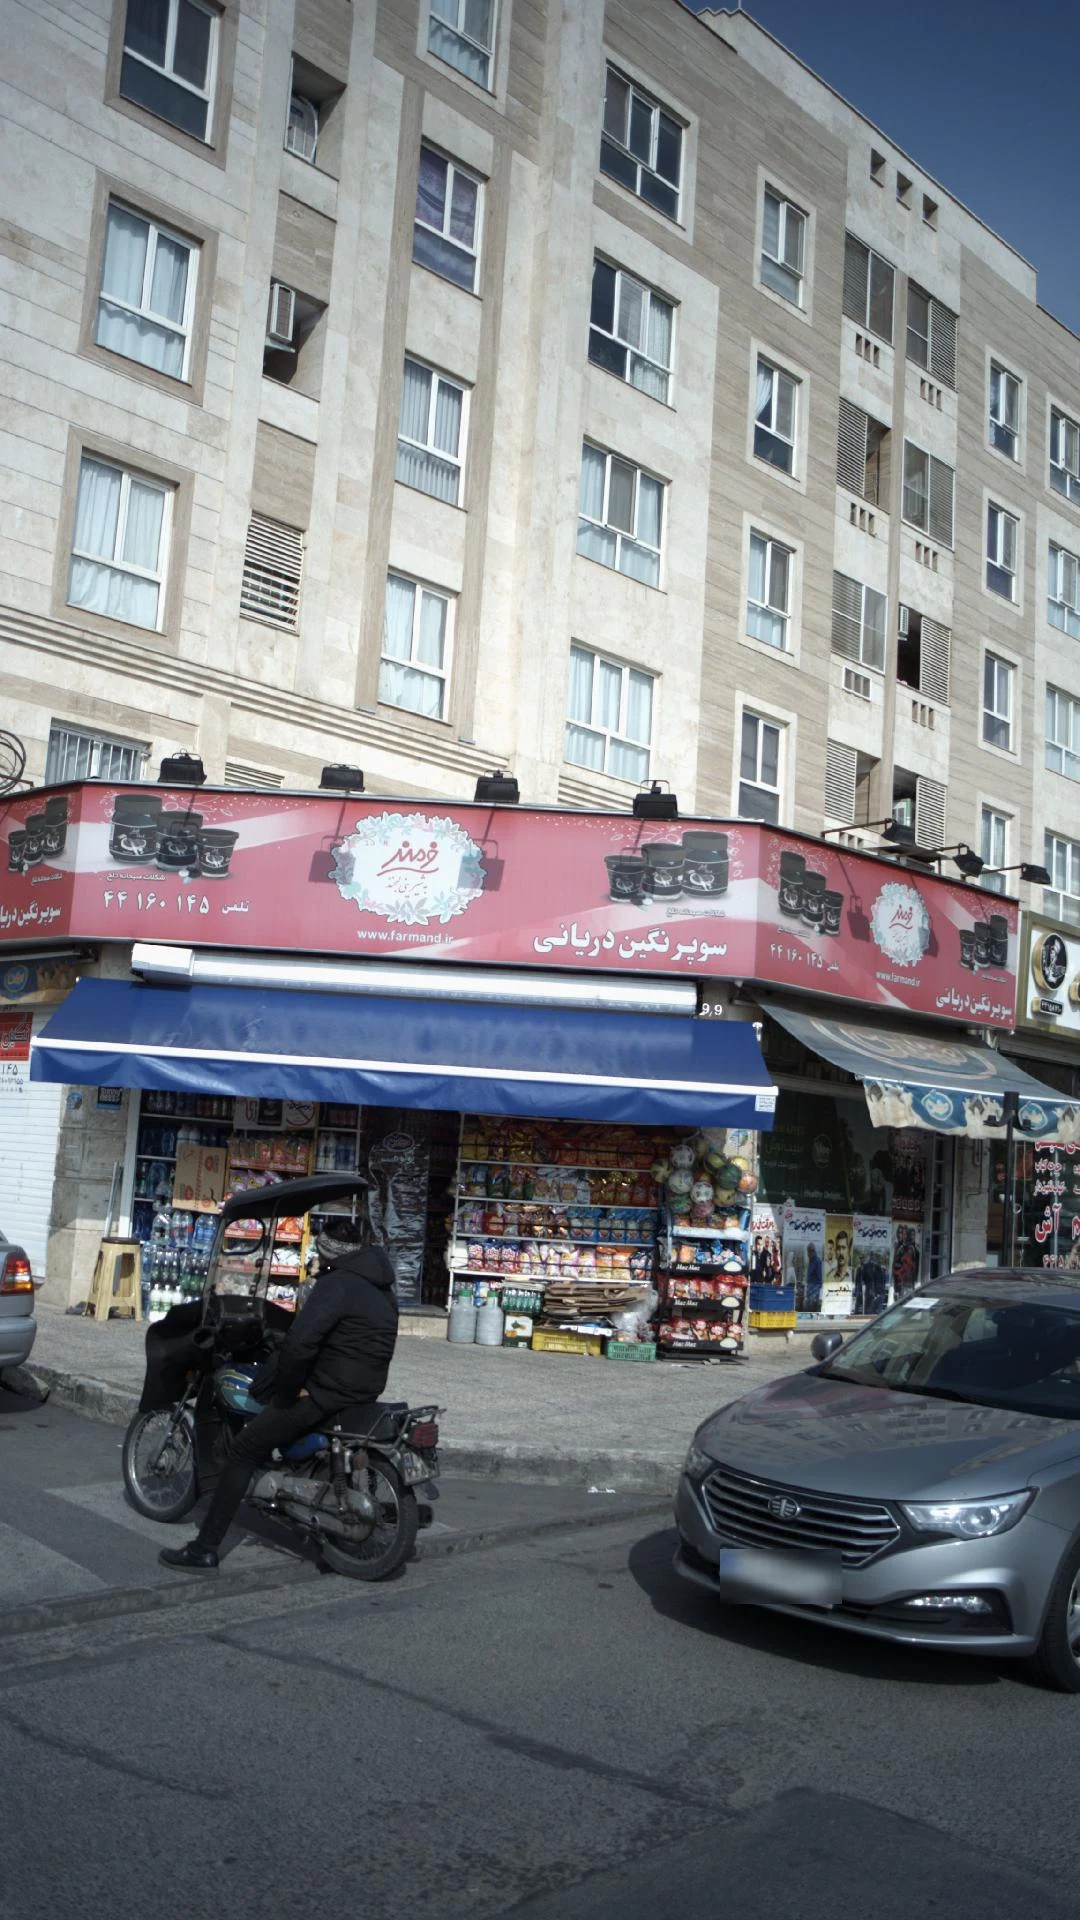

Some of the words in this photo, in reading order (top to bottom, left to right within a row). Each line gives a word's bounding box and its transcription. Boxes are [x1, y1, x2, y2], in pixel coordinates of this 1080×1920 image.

[103, 890, 128, 908] ۴۴
[137, 893, 166, 911] ۱۶۰
[177, 895, 209, 914] ۱۴۵
[357, 929, 453, 944] www.farmand.ir
[533, 922, 615, 957] دریانی
[618, 928, 670, 959] نگین
[670, 936, 727, 965] سوپر
